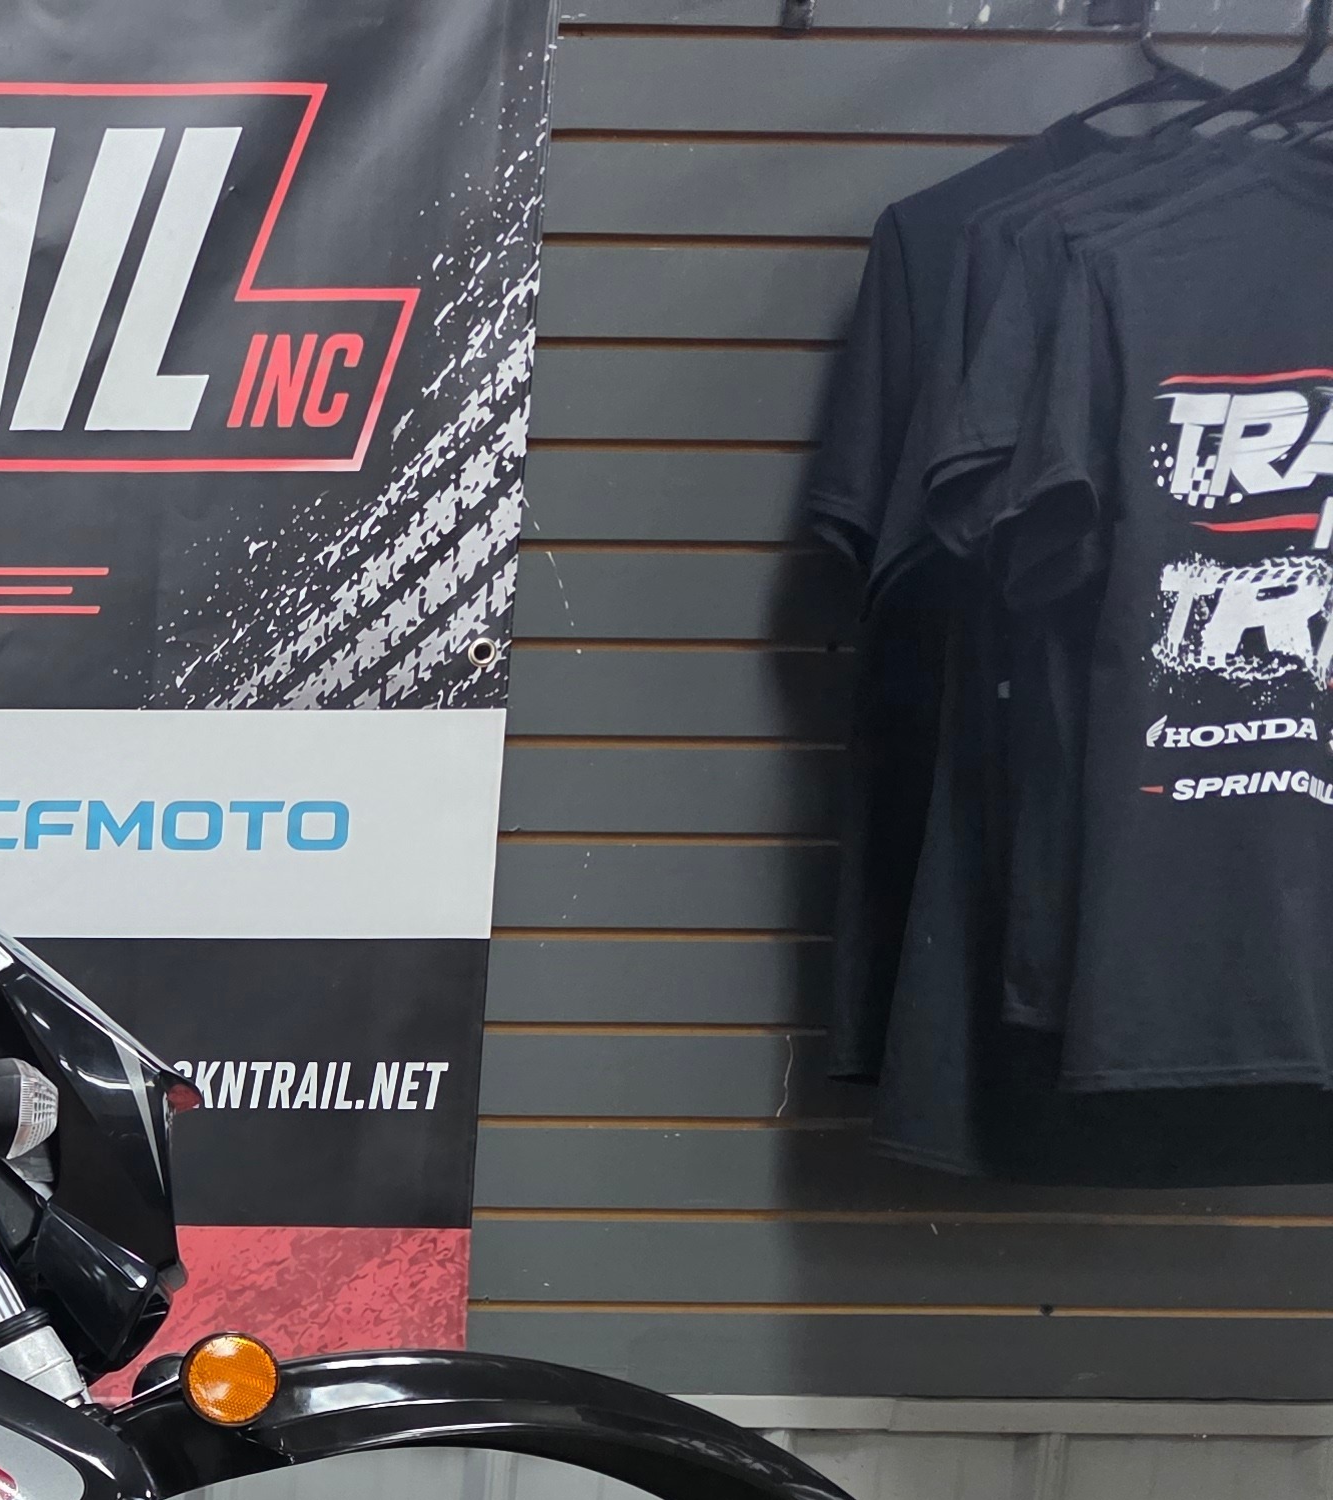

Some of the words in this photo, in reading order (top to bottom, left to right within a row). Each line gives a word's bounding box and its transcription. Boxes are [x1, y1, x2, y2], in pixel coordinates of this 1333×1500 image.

[226, 333, 362, 428] INC
[1151, 552, 1333, 692] TR
[1163, 717, 1318, 748] HONDA
[1171, 770, 1310, 801] SPRING
